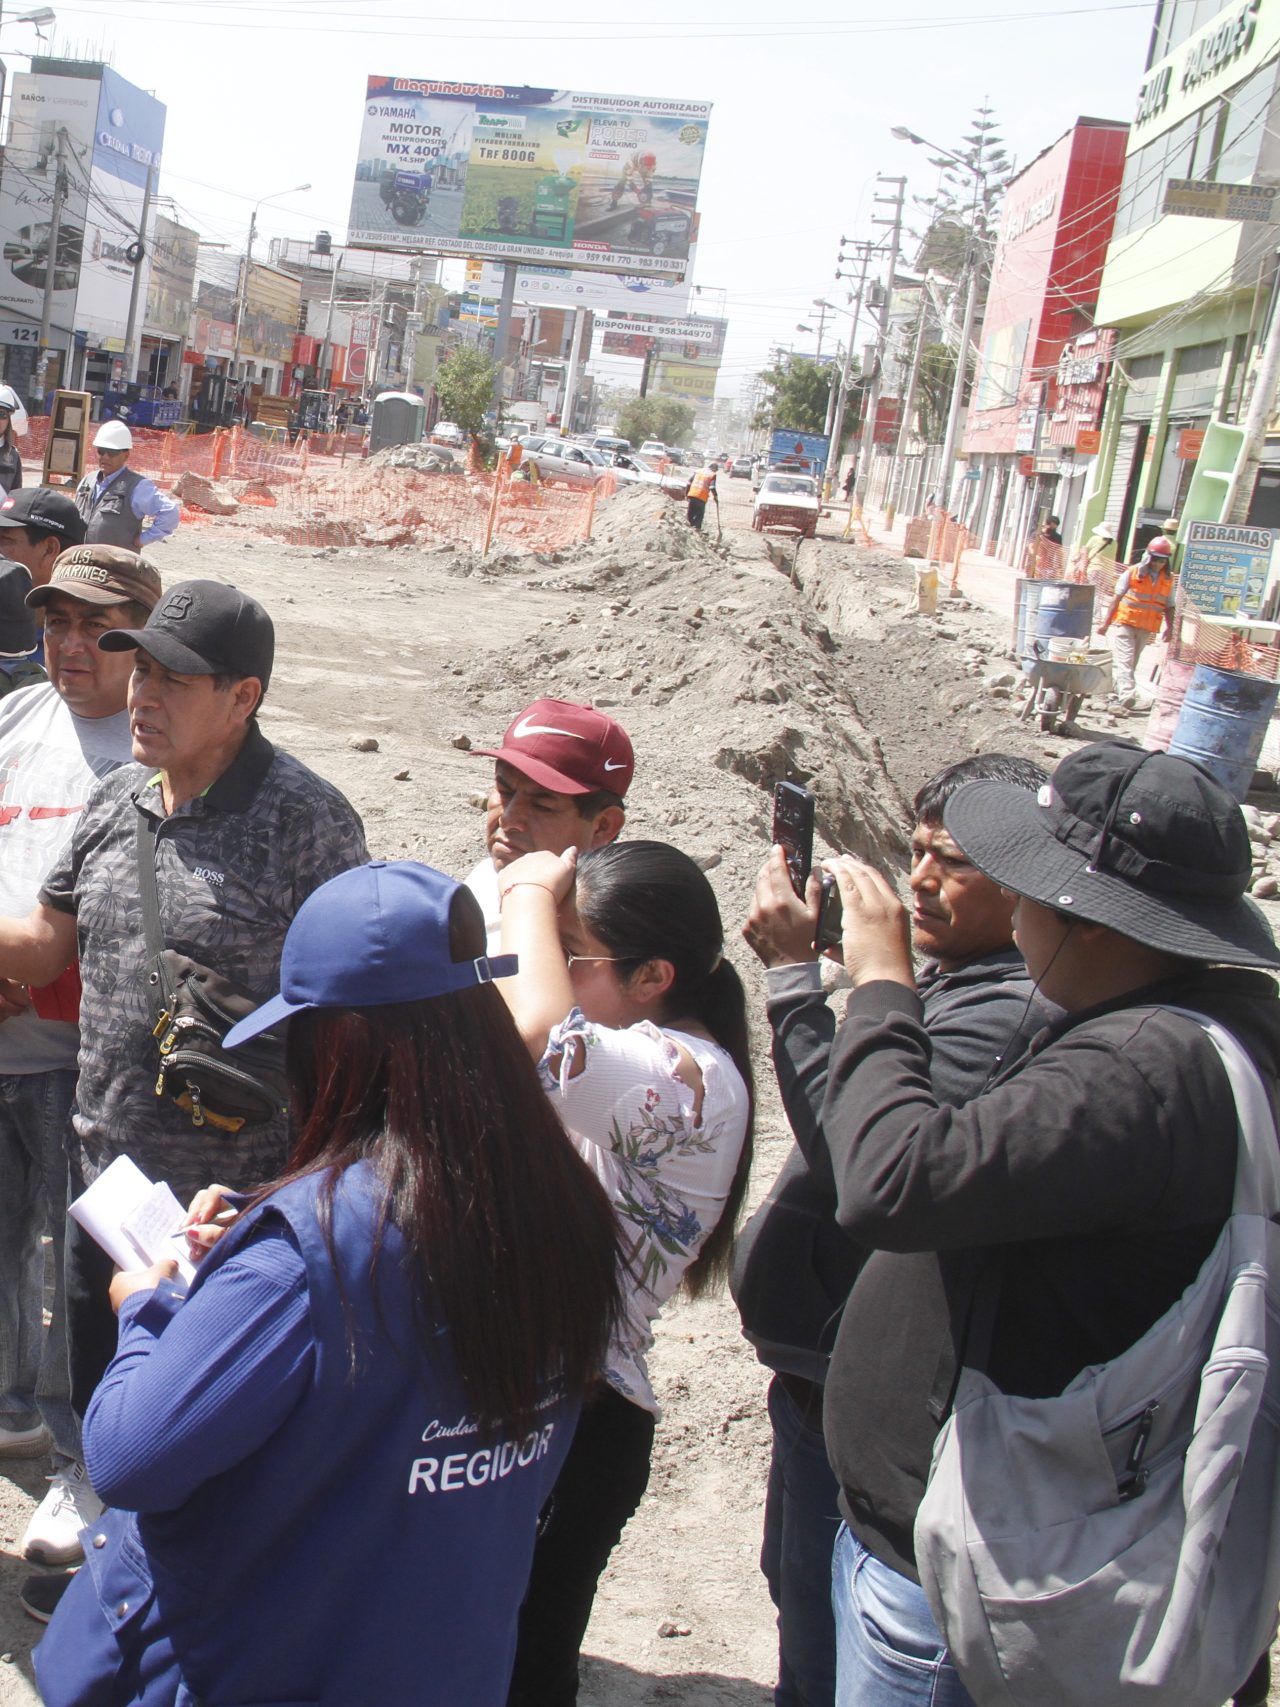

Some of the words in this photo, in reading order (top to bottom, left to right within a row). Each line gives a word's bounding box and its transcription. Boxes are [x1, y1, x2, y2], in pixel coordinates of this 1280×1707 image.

[394, 78, 504, 98] Maquindustria
[21, 94, 45, 102] BAÑOS
[572, 96, 640, 108] DISTRIBUIDOR
[642, 101, 707, 112] AUTORIZADO
[379, 106, 416, 119] YAMAHA
[390, 123, 442, 136] MOTOR
[594, 119, 618, 127] ELEVA
[592, 127, 648, 142] PODER
[387, 144, 409, 154] MX
[414, 146, 440, 157] 400
[480, 148, 499, 159] TRF
[502, 149, 536, 162] 800G
[1168, 180, 1276, 198] GASFITERO
[1162, 204, 1216, 218] PINTOR
[402, 235, 424, 244] MELGAR
[424, 237, 436, 246] REF.
[438, 239, 462, 248] COSTADO
[463, 241, 473, 249] DEL
[475, 242, 497, 250] COLEGIO
[507, 245, 522, 254] GRAN
[524, 247, 544, 256] UNIDAD
[549, 250, 573, 258] Arequipa
[573, 242, 608, 250] HONDA
[586, 253, 600, 262] 959
[602, 254, 615, 263] 941
[617, 256, 631, 264] 770
[639, 258, 652, 267] 983
[12, 328, 39, 342] 121
[595, 320, 654, 332] DISPONIBLE
[658, 327, 712, 338] 958344970
[1192, 525, 1270, 548] FIBRAMAS
[72, 550, 93, 564] U.S.
[1219, 554, 1236, 564] Baño
[57, 564, 108, 582] MARINES
[193, 866, 224, 883] BOSS
[408, 1422, 554, 1494] REGIDOR
